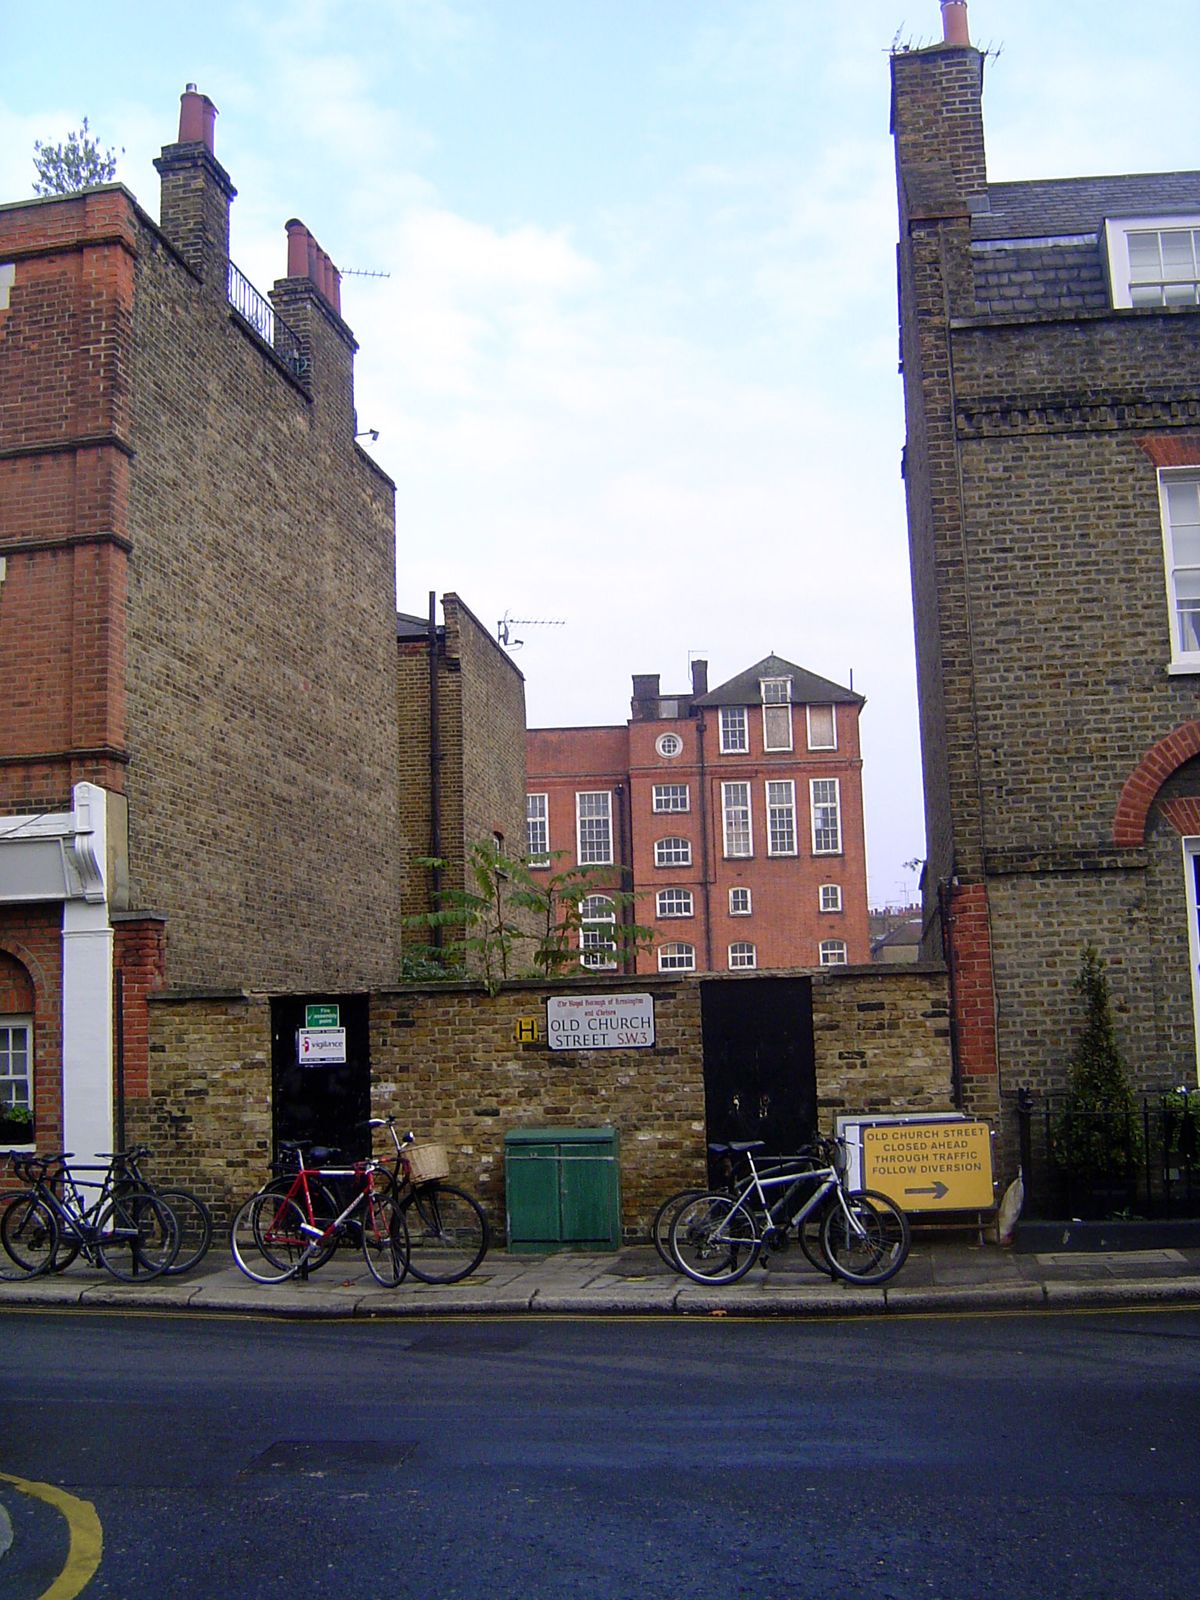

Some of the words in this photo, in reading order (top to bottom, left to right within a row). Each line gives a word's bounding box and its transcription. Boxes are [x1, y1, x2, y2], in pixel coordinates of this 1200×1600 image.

[568, 1000, 583, 1008] Royal
[585, 999, 606, 1007] Borough
[607, 998, 614, 1006] of
[615, 997, 644, 1006] Kensington
[595, 1009, 617, 1017] Chelsea
[519, 1020, 535, 1040] H
[550, 1019, 580, 1032] OLD
[587, 1016, 651, 1031] CHURCH
[311, 1040, 343, 1049] vigilance
[867, 1132, 889, 1141] OLD
[891, 1129, 939, 1140] CHURCH
[943, 1128, 985, 1138] STREET
[883, 1142, 927, 1152] CLOSED
[930, 1140, 968, 1150] AHEAD
[875, 1153, 929, 1163] THROUGH
[932, 1151, 978, 1161] TRAFFIC
[872, 1165, 917, 1175] FOLLOW
[920, 1162, 982, 1174] DIVERSION
